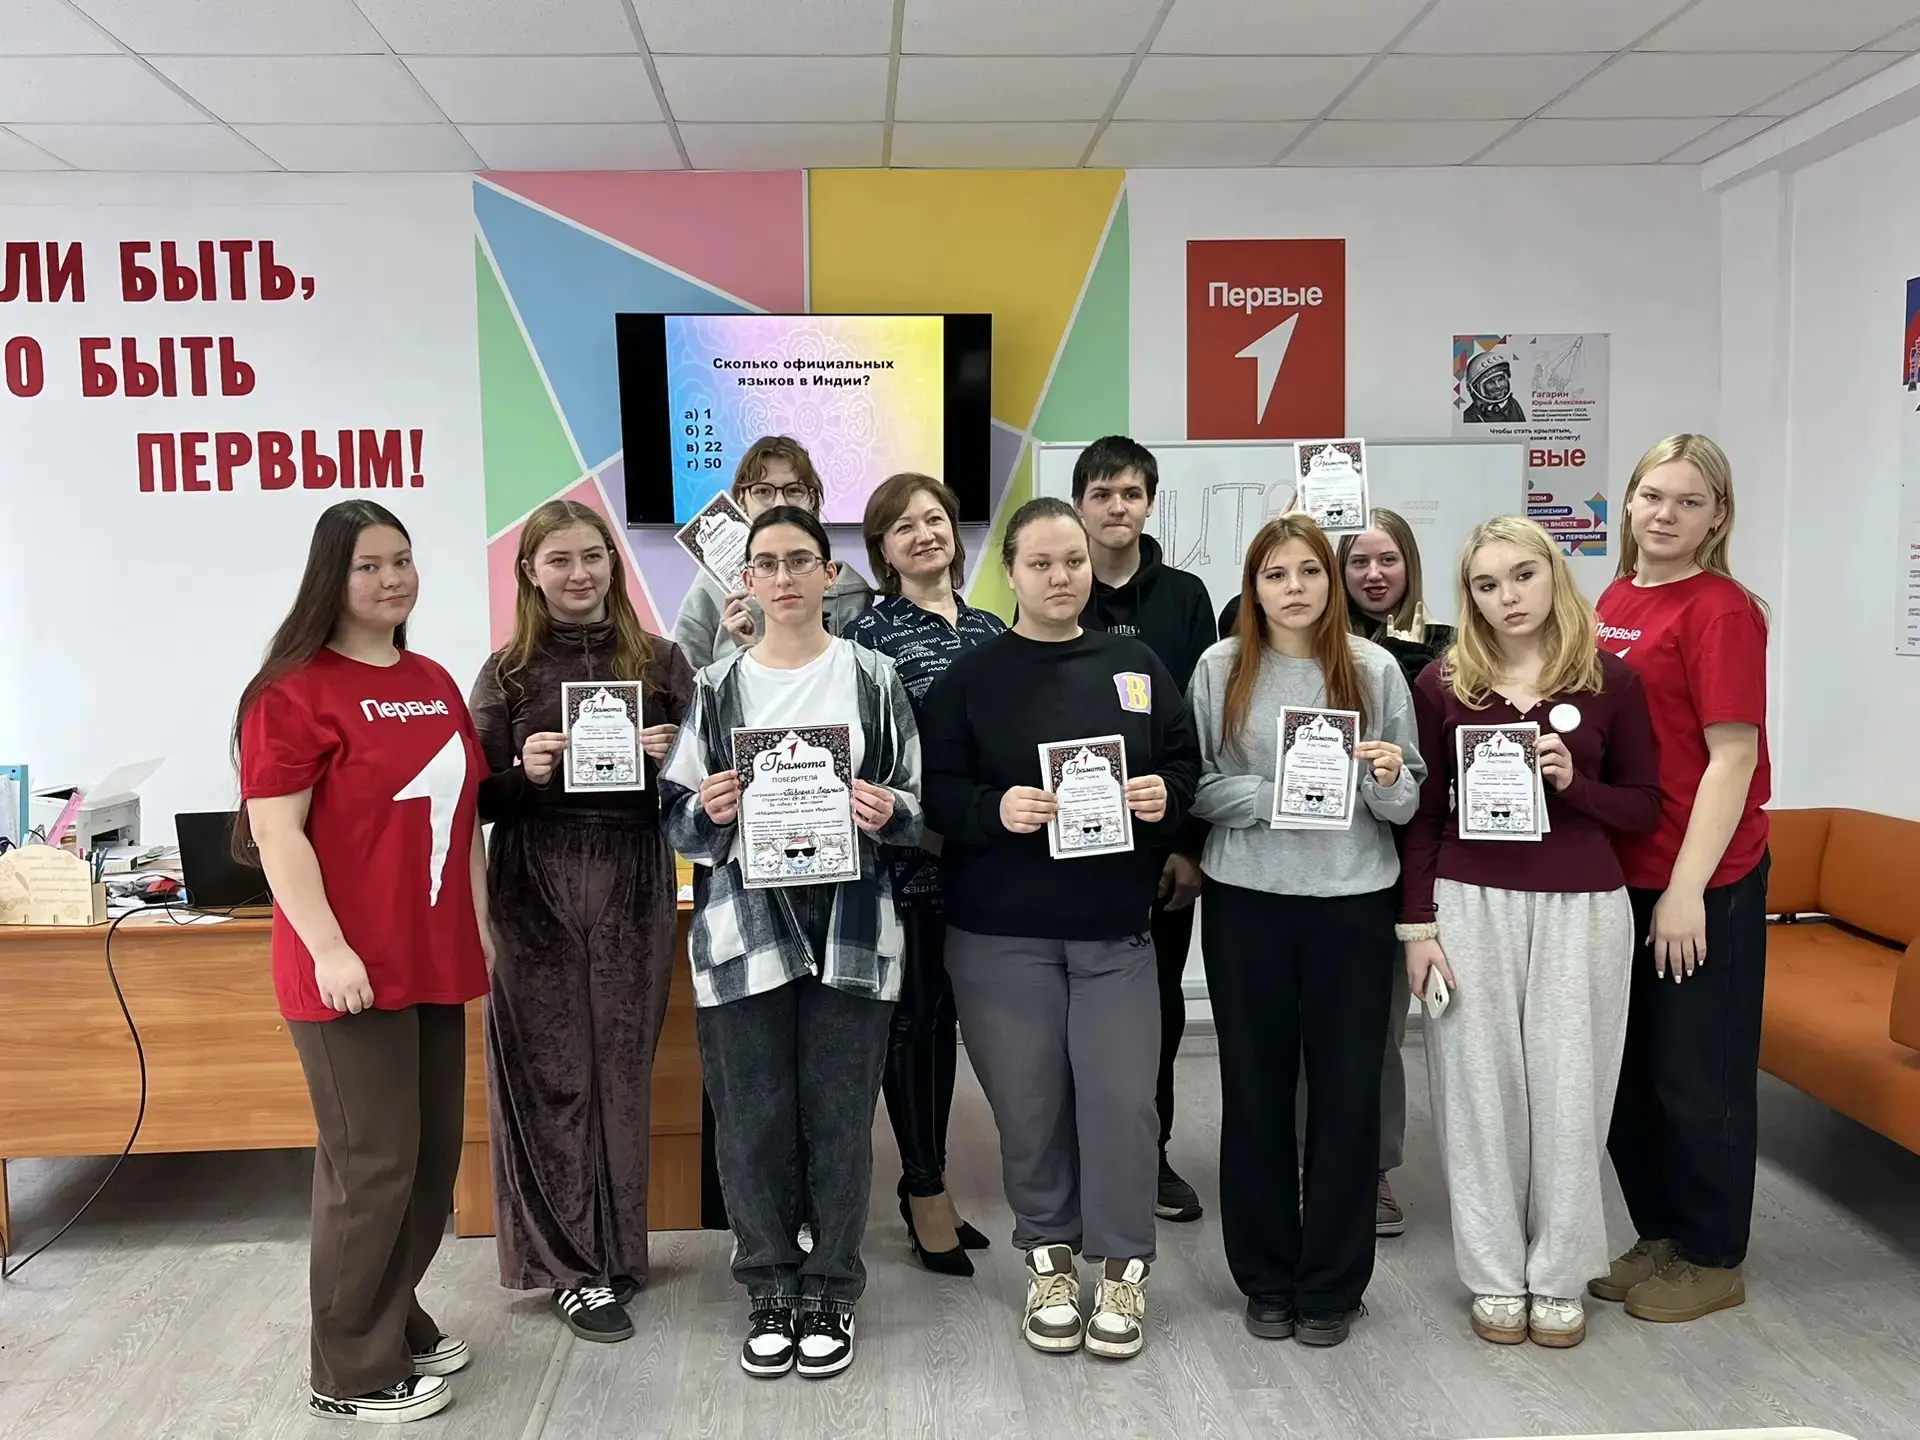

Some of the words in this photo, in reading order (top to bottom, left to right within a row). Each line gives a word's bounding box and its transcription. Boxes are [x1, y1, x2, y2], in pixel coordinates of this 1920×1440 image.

[119, 240, 316, 302] БЫТЬ,
[1209, 282, 1323, 315] Первые
[5, 336, 44, 397] О
[79, 337, 256, 397] БЫТЬ
[713, 357, 779, 370] Сколько
[783, 357, 895, 372] официальных
[737, 376, 795, 386] языков
[800, 377, 808, 386] в
[813, 375, 871, 388] Индии?
[1532, 391, 1569, 399] Гагарин
[685, 408, 699, 420] а)
[704, 409, 712, 419] 1
[685, 425, 700, 437] б)
[704, 425, 714, 436] 2
[686, 441, 700, 453] в)
[704, 441, 723, 452] 22
[137, 428, 424, 492] ПЕРВЫМ!
[687, 458, 700, 470] г)
[704, 458, 722, 469] 50
[1123, 675, 1148, 709] B
[360, 699, 449, 723] Первые
[583, 700, 622, 714] Грамота
[1299, 727, 1339, 743] Грамота
[1478, 744, 1520, 759] Грамота
[761, 752, 826, 773] Грамота
[1066, 761, 1106, 775] Грамота
[772, 774, 818, 783] ПОБЕДИТЕЛЯ
